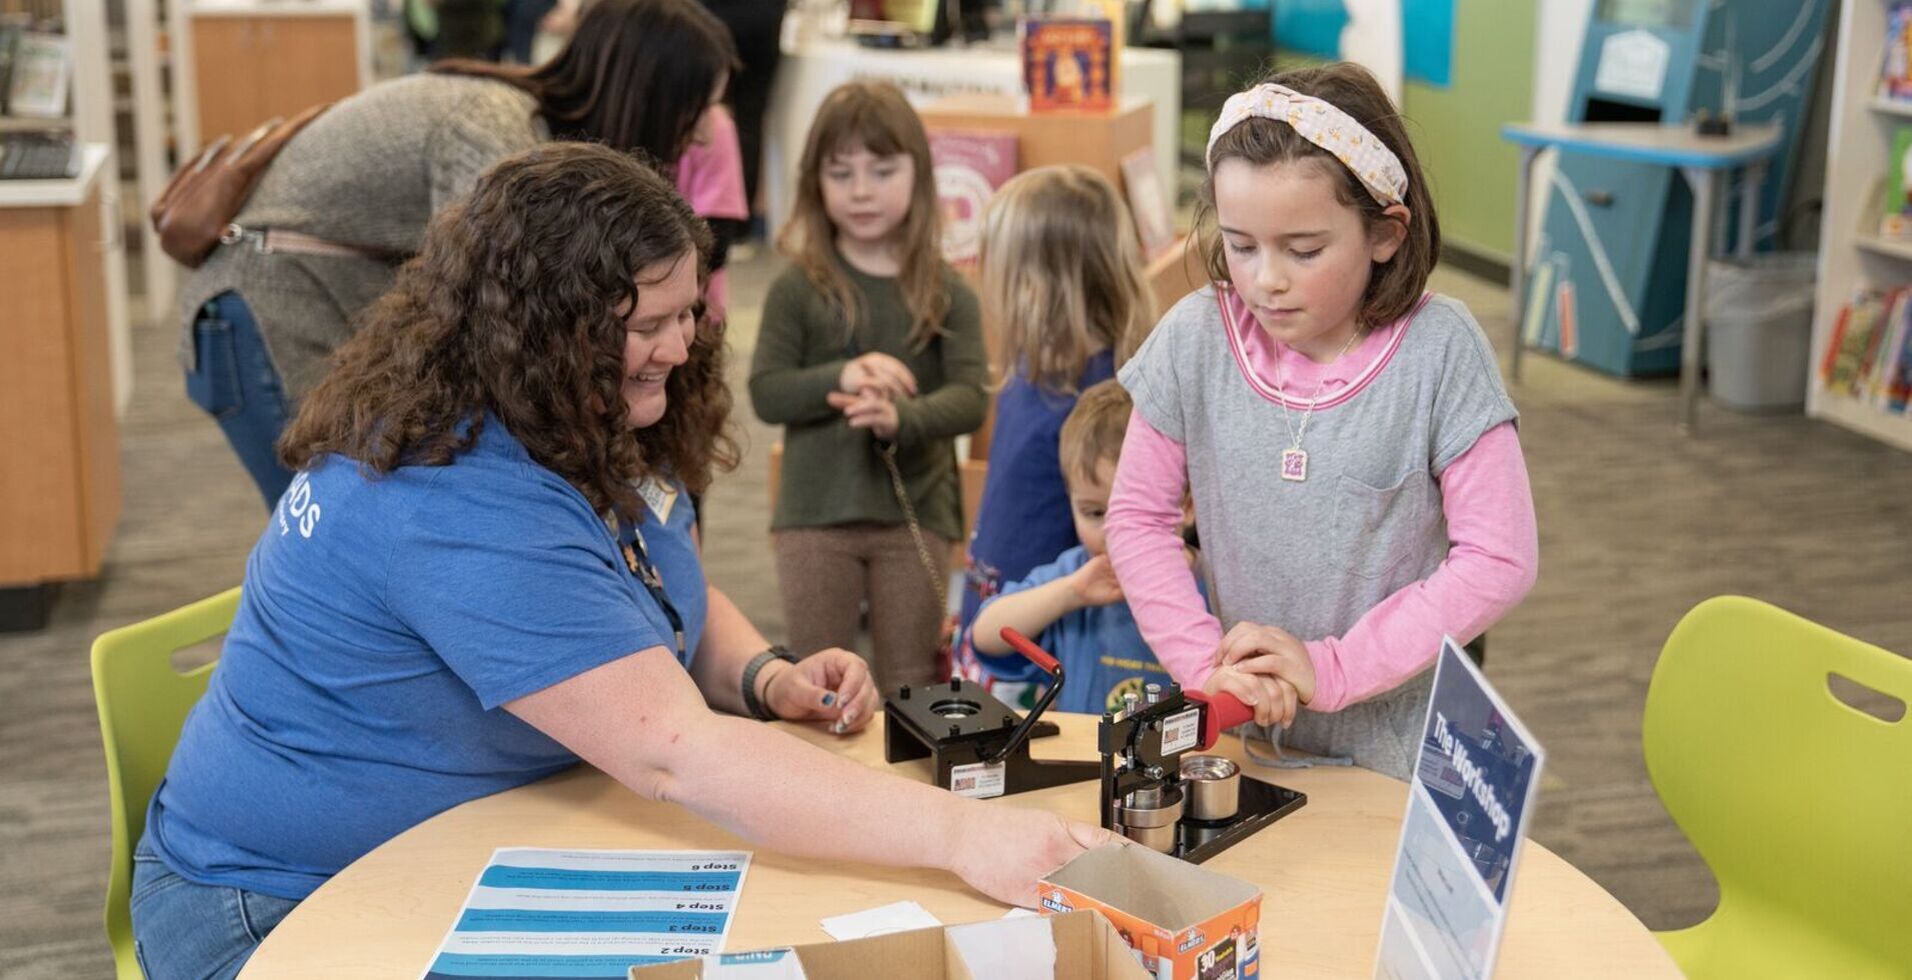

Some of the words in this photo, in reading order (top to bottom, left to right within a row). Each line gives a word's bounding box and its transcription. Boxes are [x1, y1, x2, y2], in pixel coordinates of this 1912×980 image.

[1434, 711, 1454, 756] The
[1452, 738, 1511, 842] Workshop
[695, 883, 730, 891] Step
[689, 902, 724, 910] Step
[681, 924, 717, 932] Step
[661, 947, 670, 955] 2
[673, 946, 710, 955] Step
[1200, 950, 1216, 973] 30
